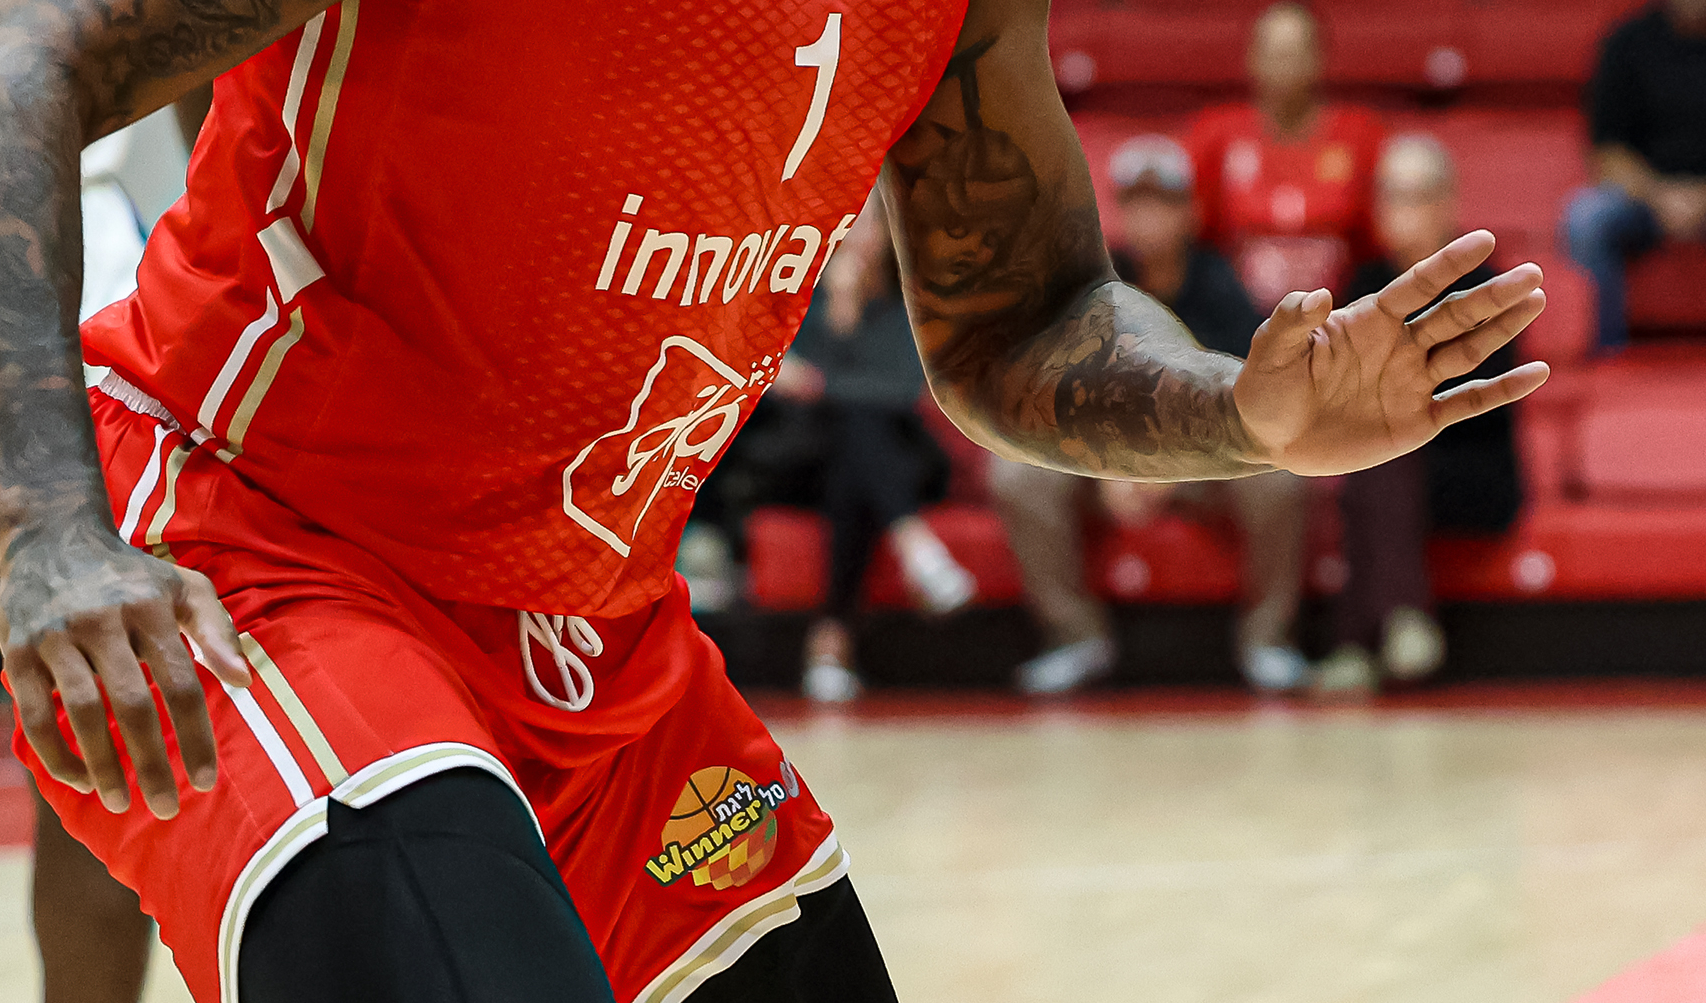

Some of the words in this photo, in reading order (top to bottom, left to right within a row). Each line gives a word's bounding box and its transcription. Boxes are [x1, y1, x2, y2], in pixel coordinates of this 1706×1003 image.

[781, 13, 842, 183] 1
[646, 799, 761, 884] Winner
[757, 783, 785, 807] סל
[716, 783, 753, 822] ליגת
